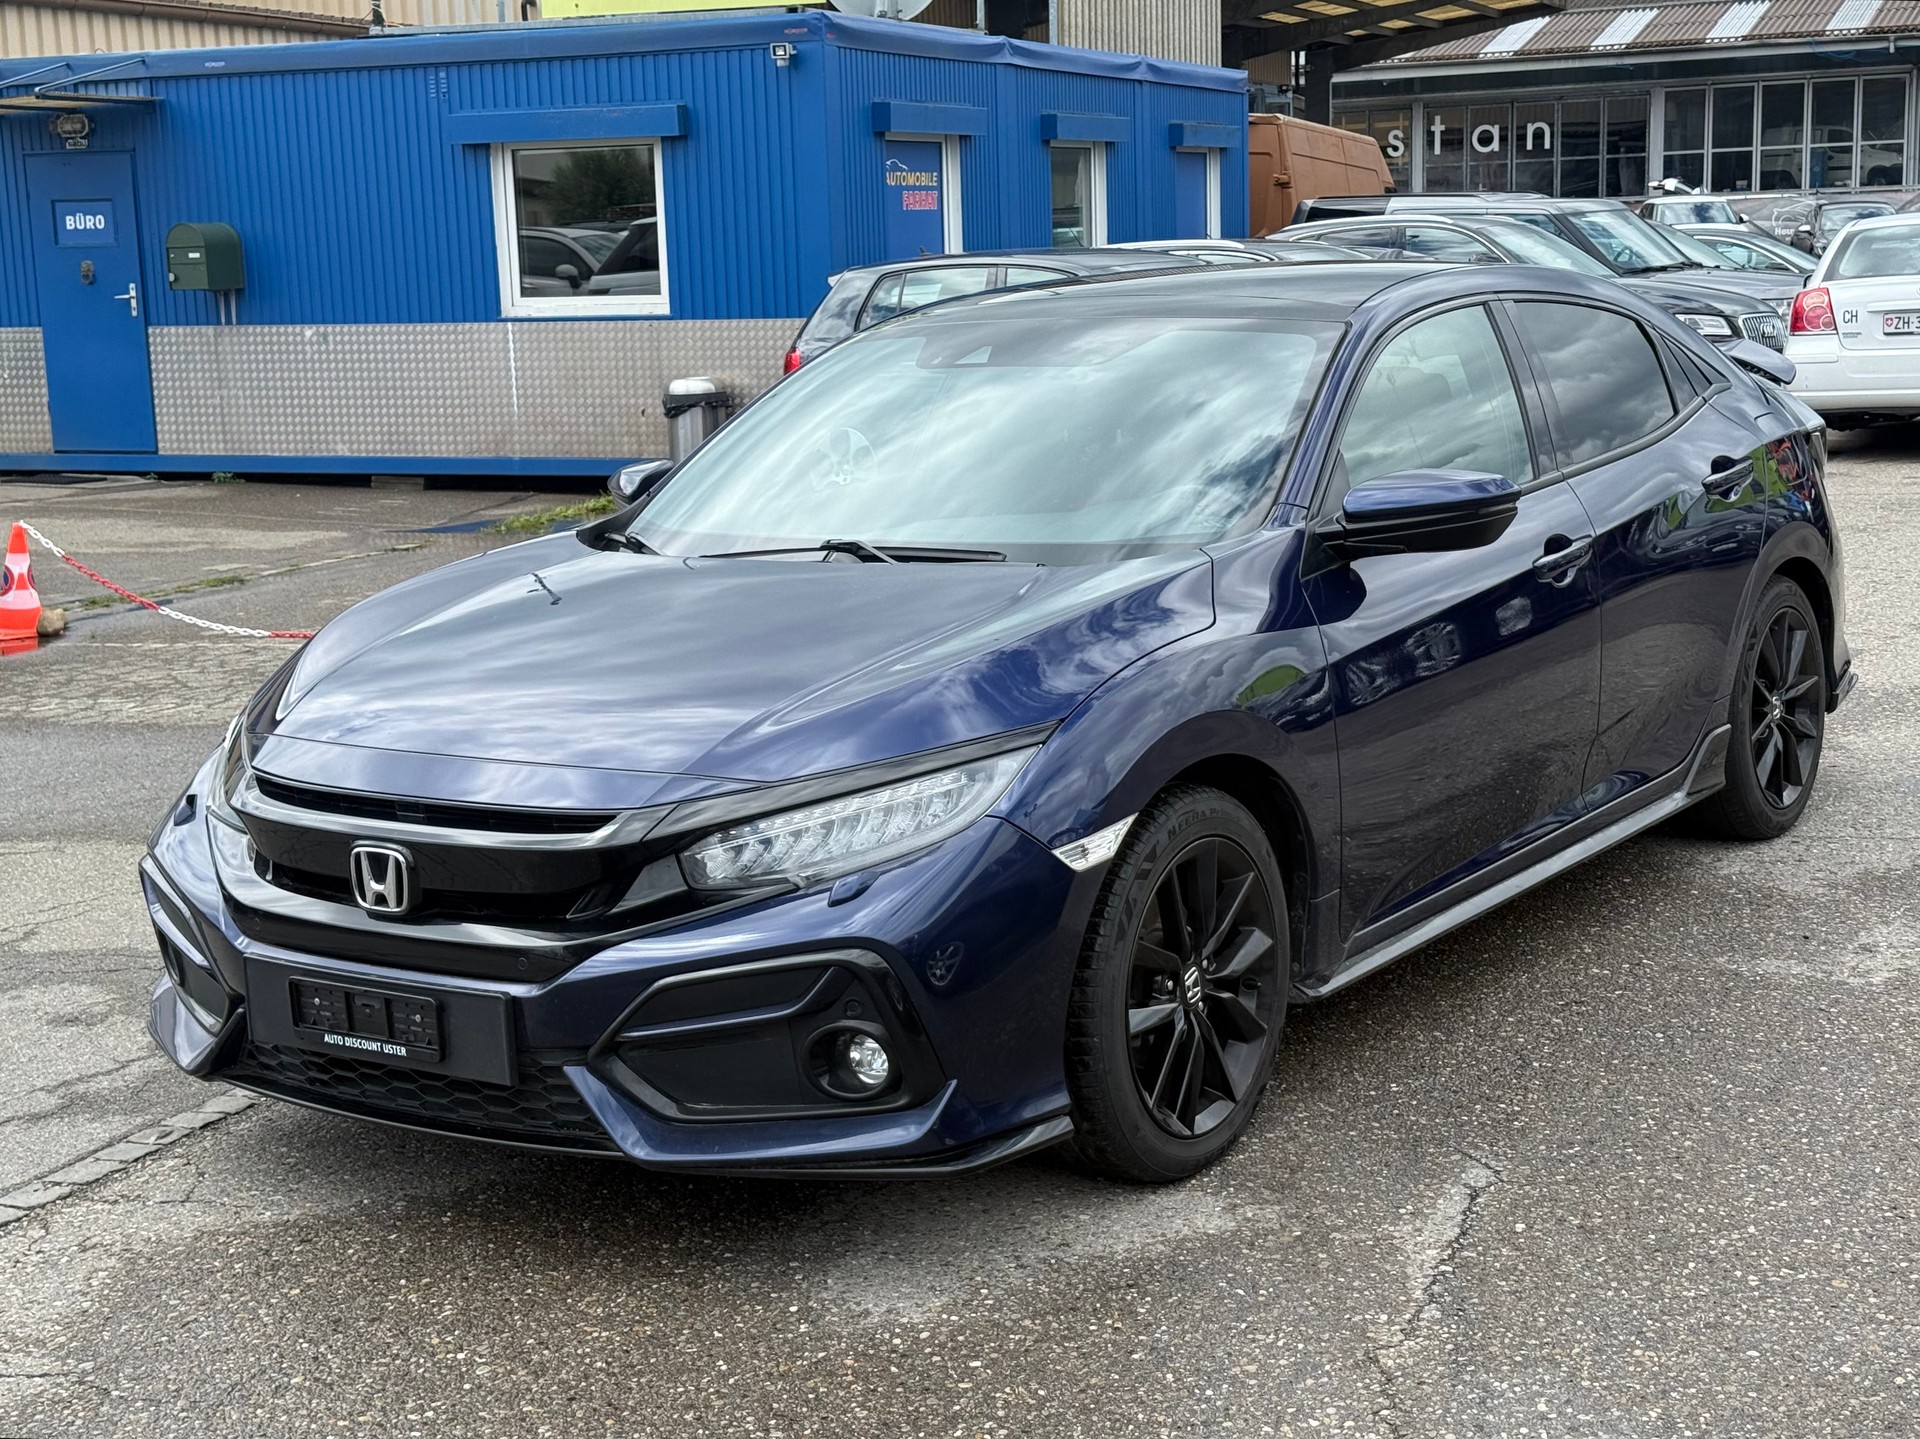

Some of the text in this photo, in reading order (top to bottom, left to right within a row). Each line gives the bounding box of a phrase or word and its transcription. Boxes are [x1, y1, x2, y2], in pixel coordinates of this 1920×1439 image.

[65, 212, 105, 230] BÜRO
[1842, 309, 1858, 324] CH
[324, 1033, 407, 1057] AUTO DISCOUNT USTER
